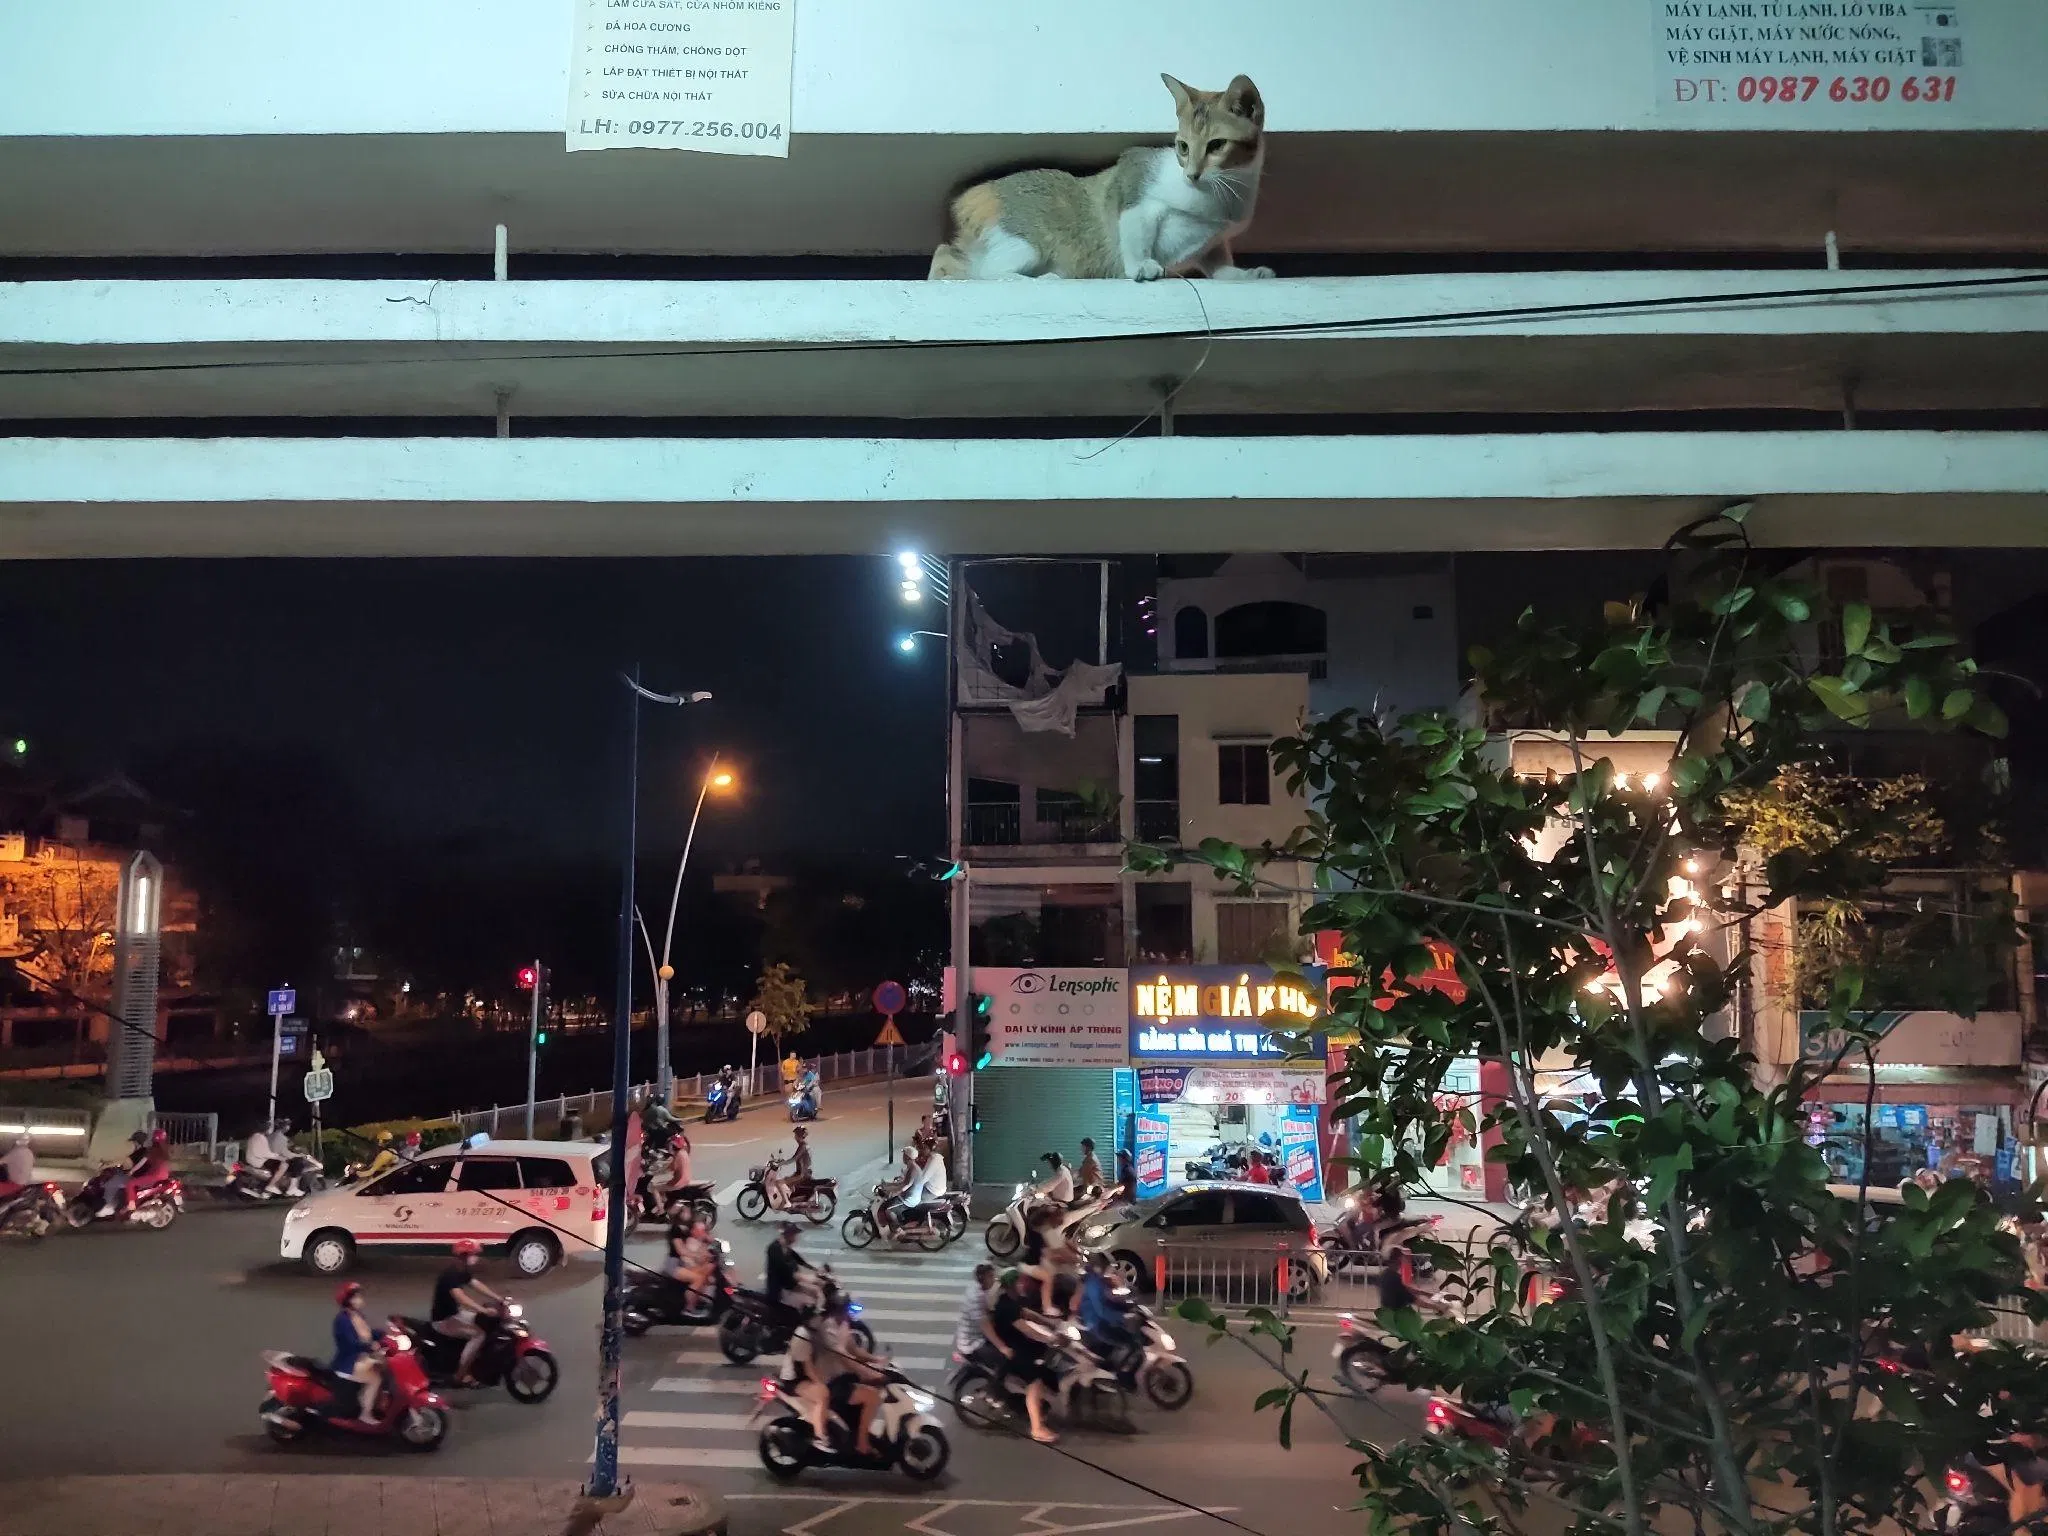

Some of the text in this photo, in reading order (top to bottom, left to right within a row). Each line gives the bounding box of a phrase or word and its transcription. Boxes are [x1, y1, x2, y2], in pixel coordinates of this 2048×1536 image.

[1665, 1, 1702, 17] MÁY
[1707, 3, 1757, 20] LẠNH,
[1760, 0, 1783, 17] TỦ
[1867, 3, 1908, 17] VIBA
[605, 19, 691, 32] ĐÁ HOA CƯƠNG
[1666, 24, 1703, 41] MÁY
[1707, 26, 1753, 43] GIẶT,
[1757, 24, 1795, 41] MÁY
[1800, 24, 1845, 41] NƯỚC
[1668, 47, 1917, 67] VỆ SINH MÁY LẠNH, MÁY GIẶT
[627, 68, 649, 78] ĐẠT
[652, 67, 682, 77] THIẾT
[685, 69, 696, 79] BỊ
[698, 69, 717, 80] NỘI
[720, 69, 748, 79] THẤT
[602, 89, 626, 99] SỬA
[684, 91, 713, 101] THẤT
[1673, 75, 1956, 103] ĐT: 0987 630 631
[580, 118, 782, 140] LH: 0977.256.004
[1049, 974, 1120, 996] Lensoptic
[1136, 974, 1199, 1025] NỆM
[1203, 972, 1252, 1017] GIÁ
